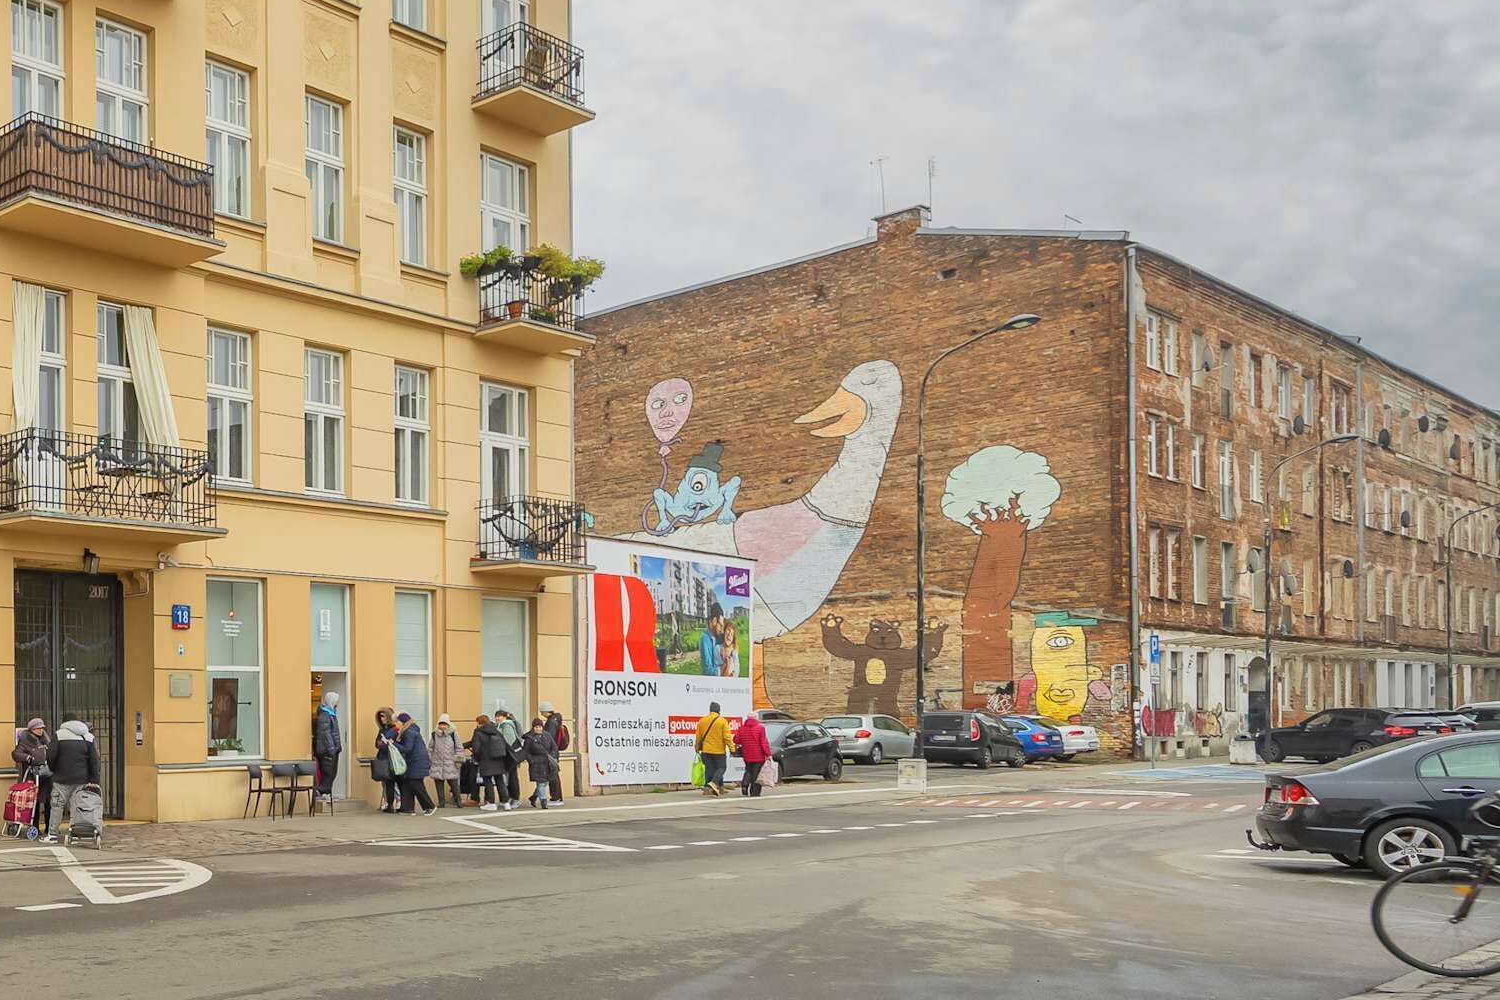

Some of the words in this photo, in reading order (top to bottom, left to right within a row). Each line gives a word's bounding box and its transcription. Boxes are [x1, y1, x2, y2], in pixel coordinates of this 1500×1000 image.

[88, 585, 109, 599] 2017
[177, 610, 189, 624] 18
[594, 680, 657, 696] RONSON
[594, 717, 653, 732] Zamieszkaj
[654, 721, 666, 730] na
[669, 718, 698, 732] gotow
[595, 736, 640, 747] Ostatnie
[642, 736, 694, 748] mieszkania
[606, 762, 618, 773] 22
[620, 762, 636, 772] 749
[650, 761, 660, 772] 52
